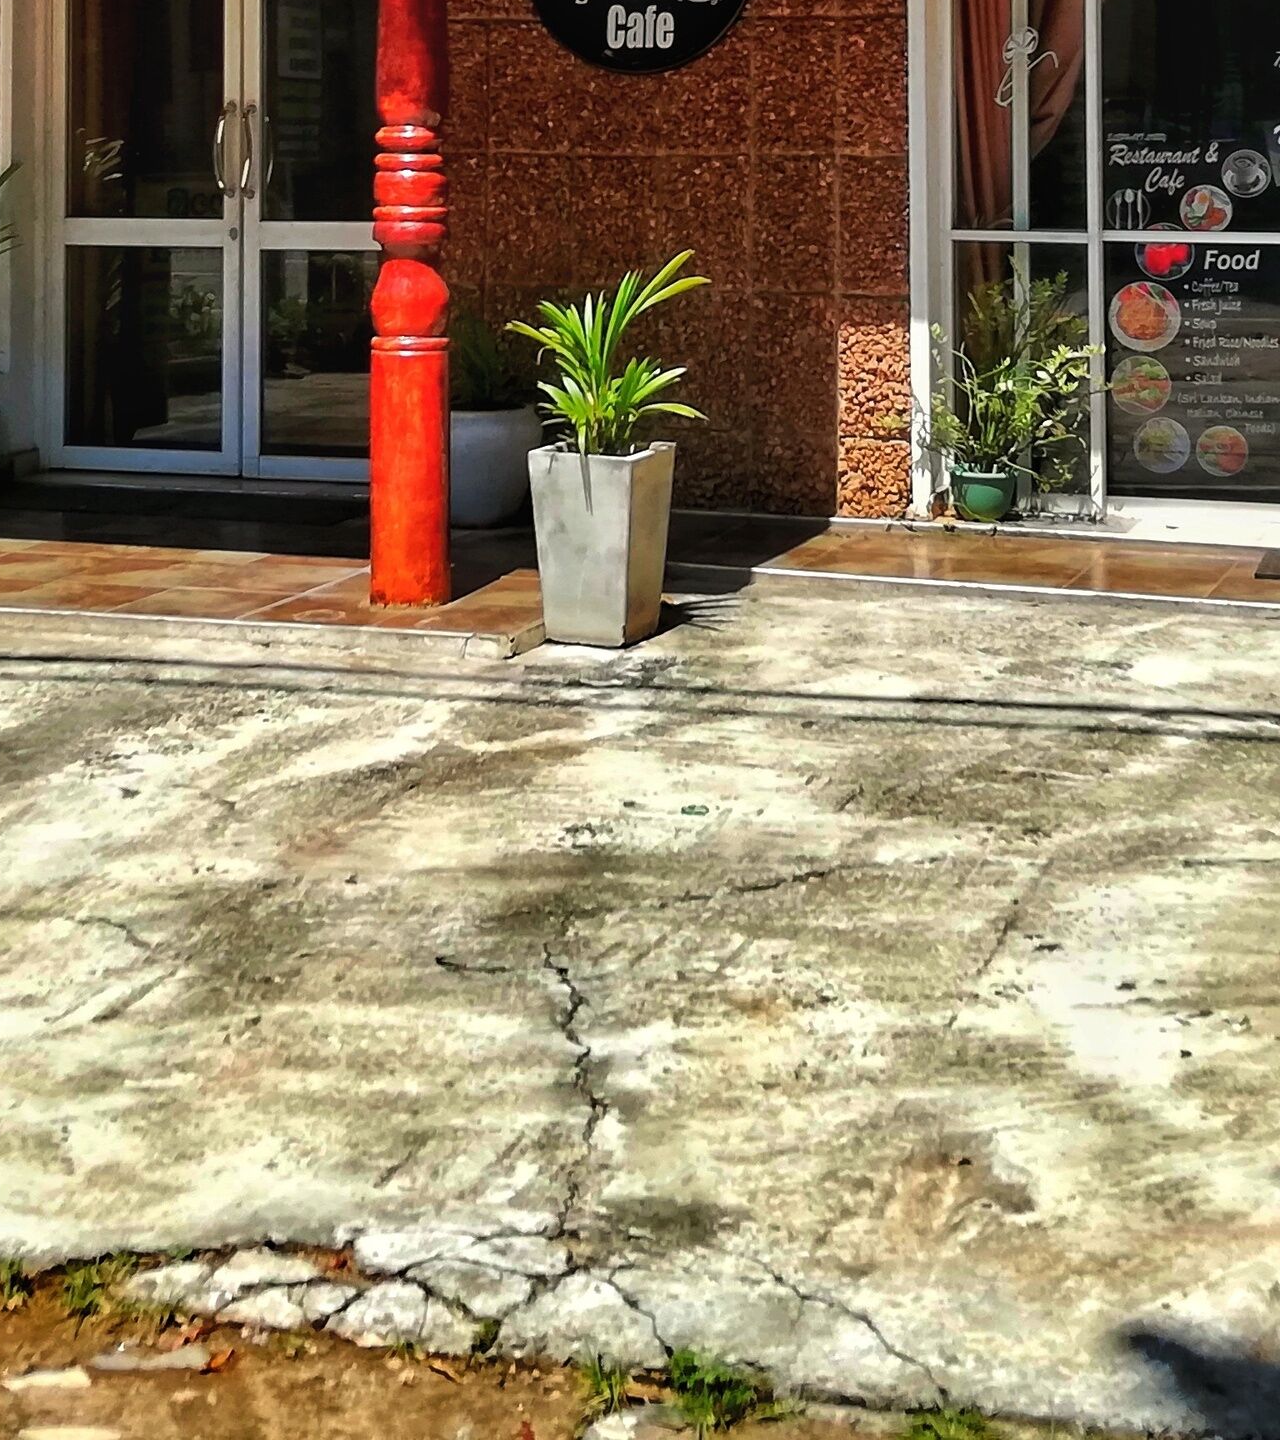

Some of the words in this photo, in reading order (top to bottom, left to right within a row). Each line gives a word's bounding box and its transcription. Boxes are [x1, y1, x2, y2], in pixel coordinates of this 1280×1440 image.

[606, 4, 675, 49] Cafe
[1108, 144, 1201, 166] Restaurant
[1205, 141, 1219, 163] &
[1145, 166, 1185, 196] Cafe
[1203, 249, 1261, 271] Food
